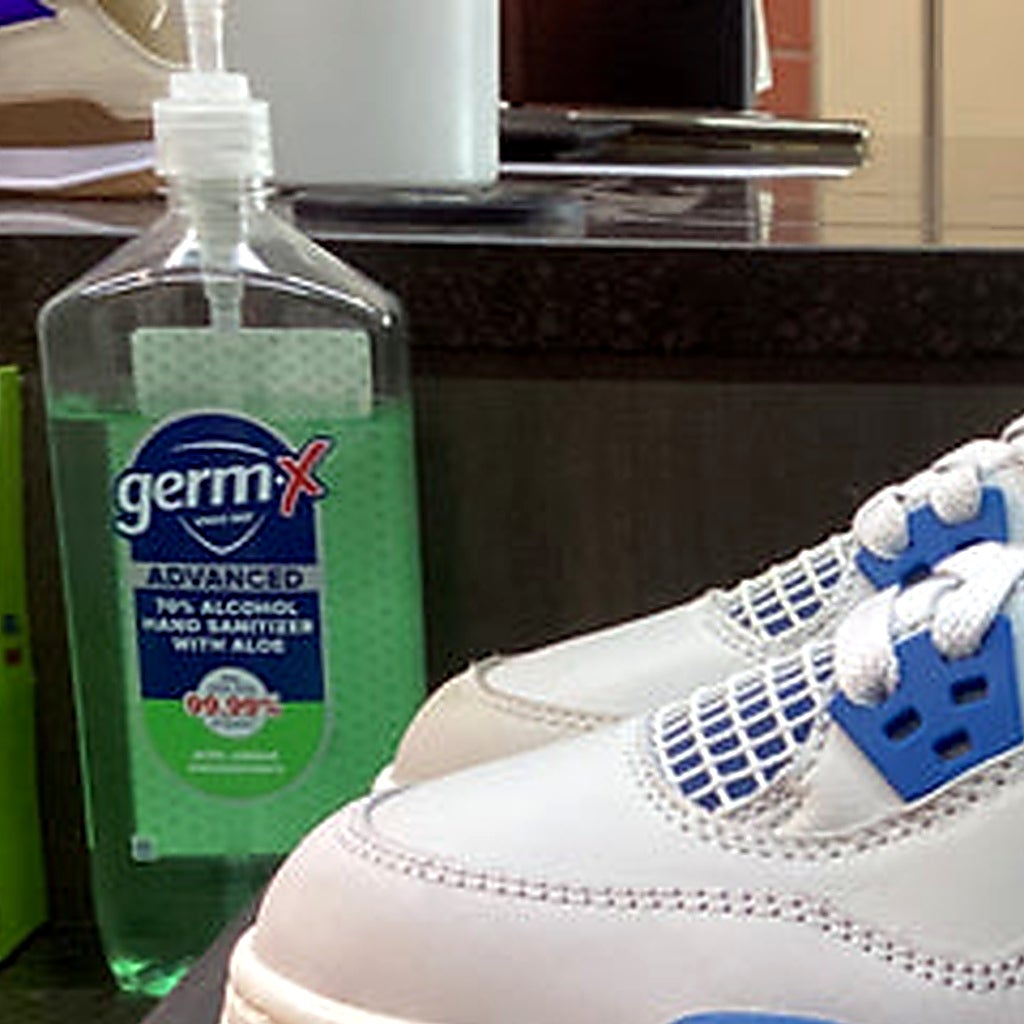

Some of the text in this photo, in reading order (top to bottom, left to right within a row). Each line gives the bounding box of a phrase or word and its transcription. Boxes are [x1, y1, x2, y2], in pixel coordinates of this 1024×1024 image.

[147, 567, 305, 589] ADVANCED
[156, 598, 299, 617] 70% ALCOHOL
[142, 618, 314, 635] HAND SANITIZER
[171, 637, 287, 655] WITH ALOE
[184, 692, 284, 717] 99.99%
